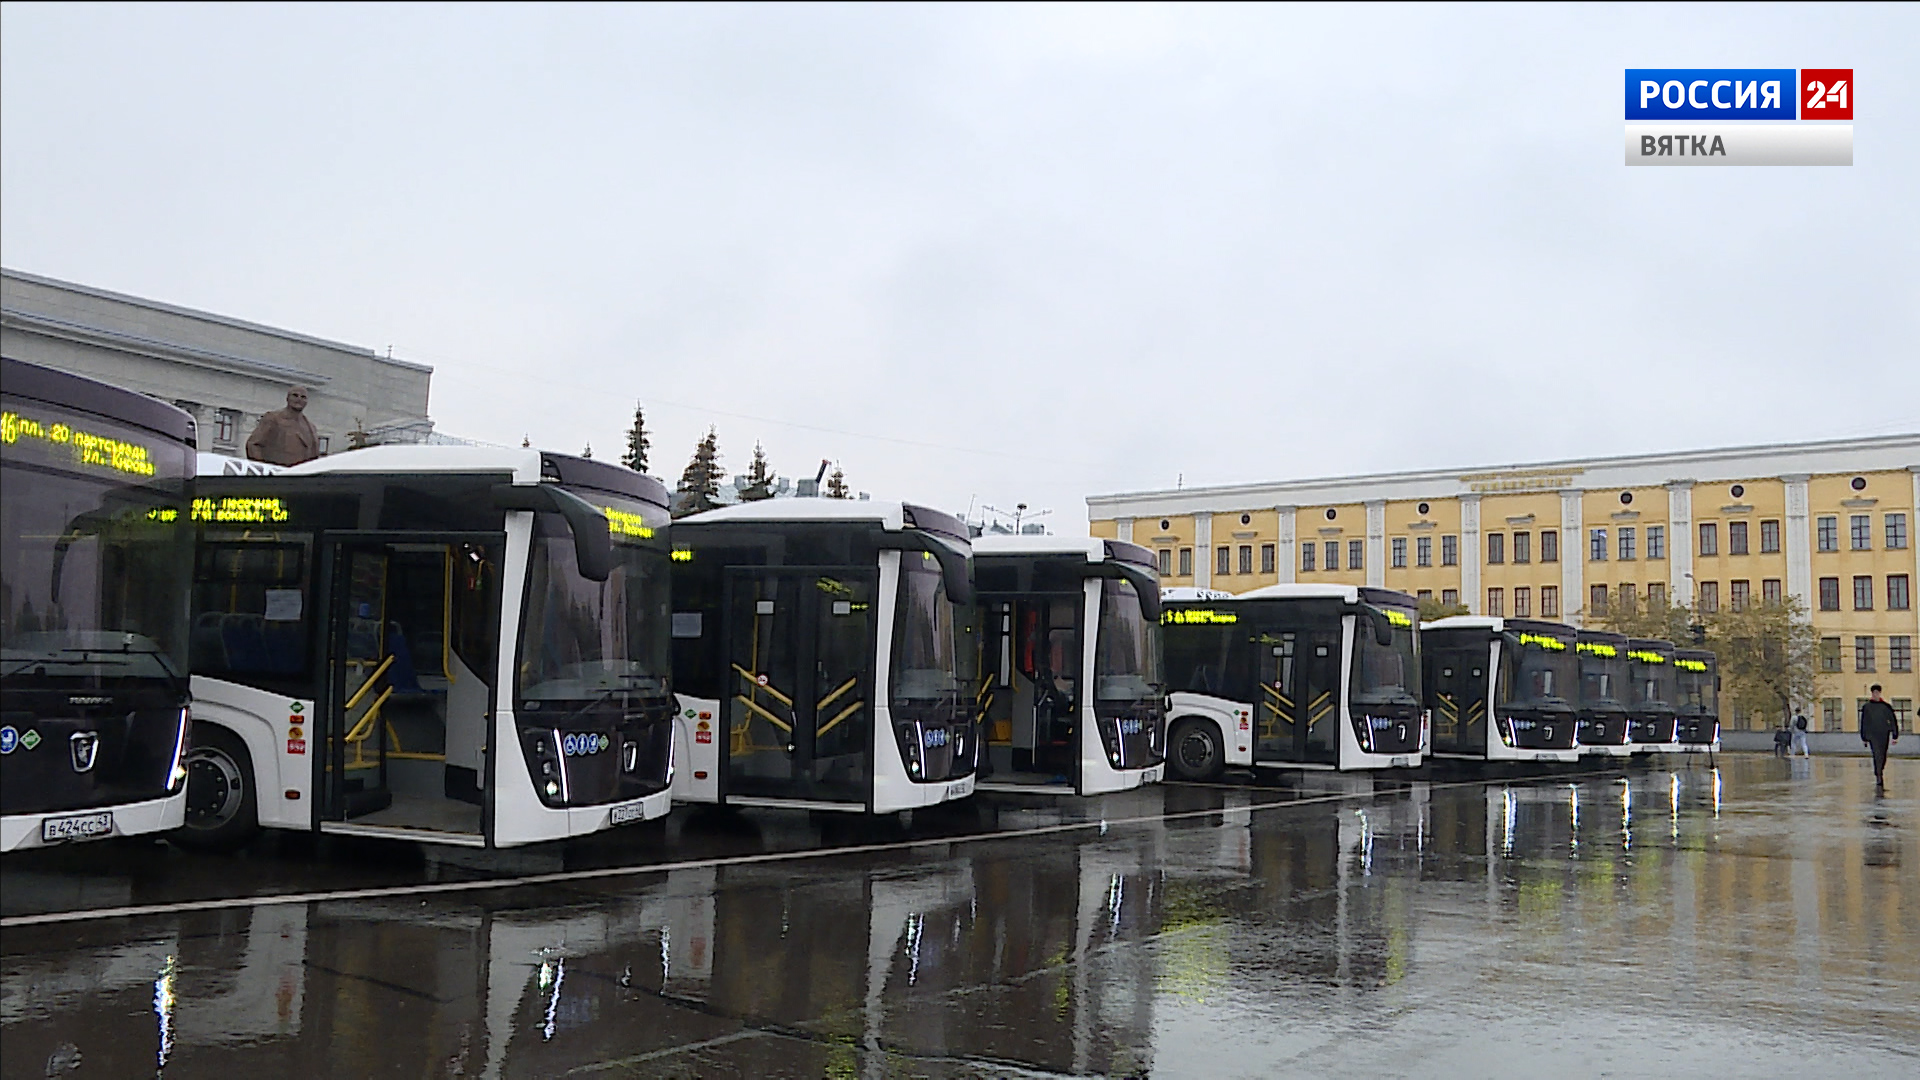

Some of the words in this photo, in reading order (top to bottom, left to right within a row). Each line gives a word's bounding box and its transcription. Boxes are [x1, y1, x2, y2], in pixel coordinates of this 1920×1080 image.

[19, 418, 44, 438] пл.
[51, 423, 70, 443] 20
[83, 449, 106, 465] ул.
